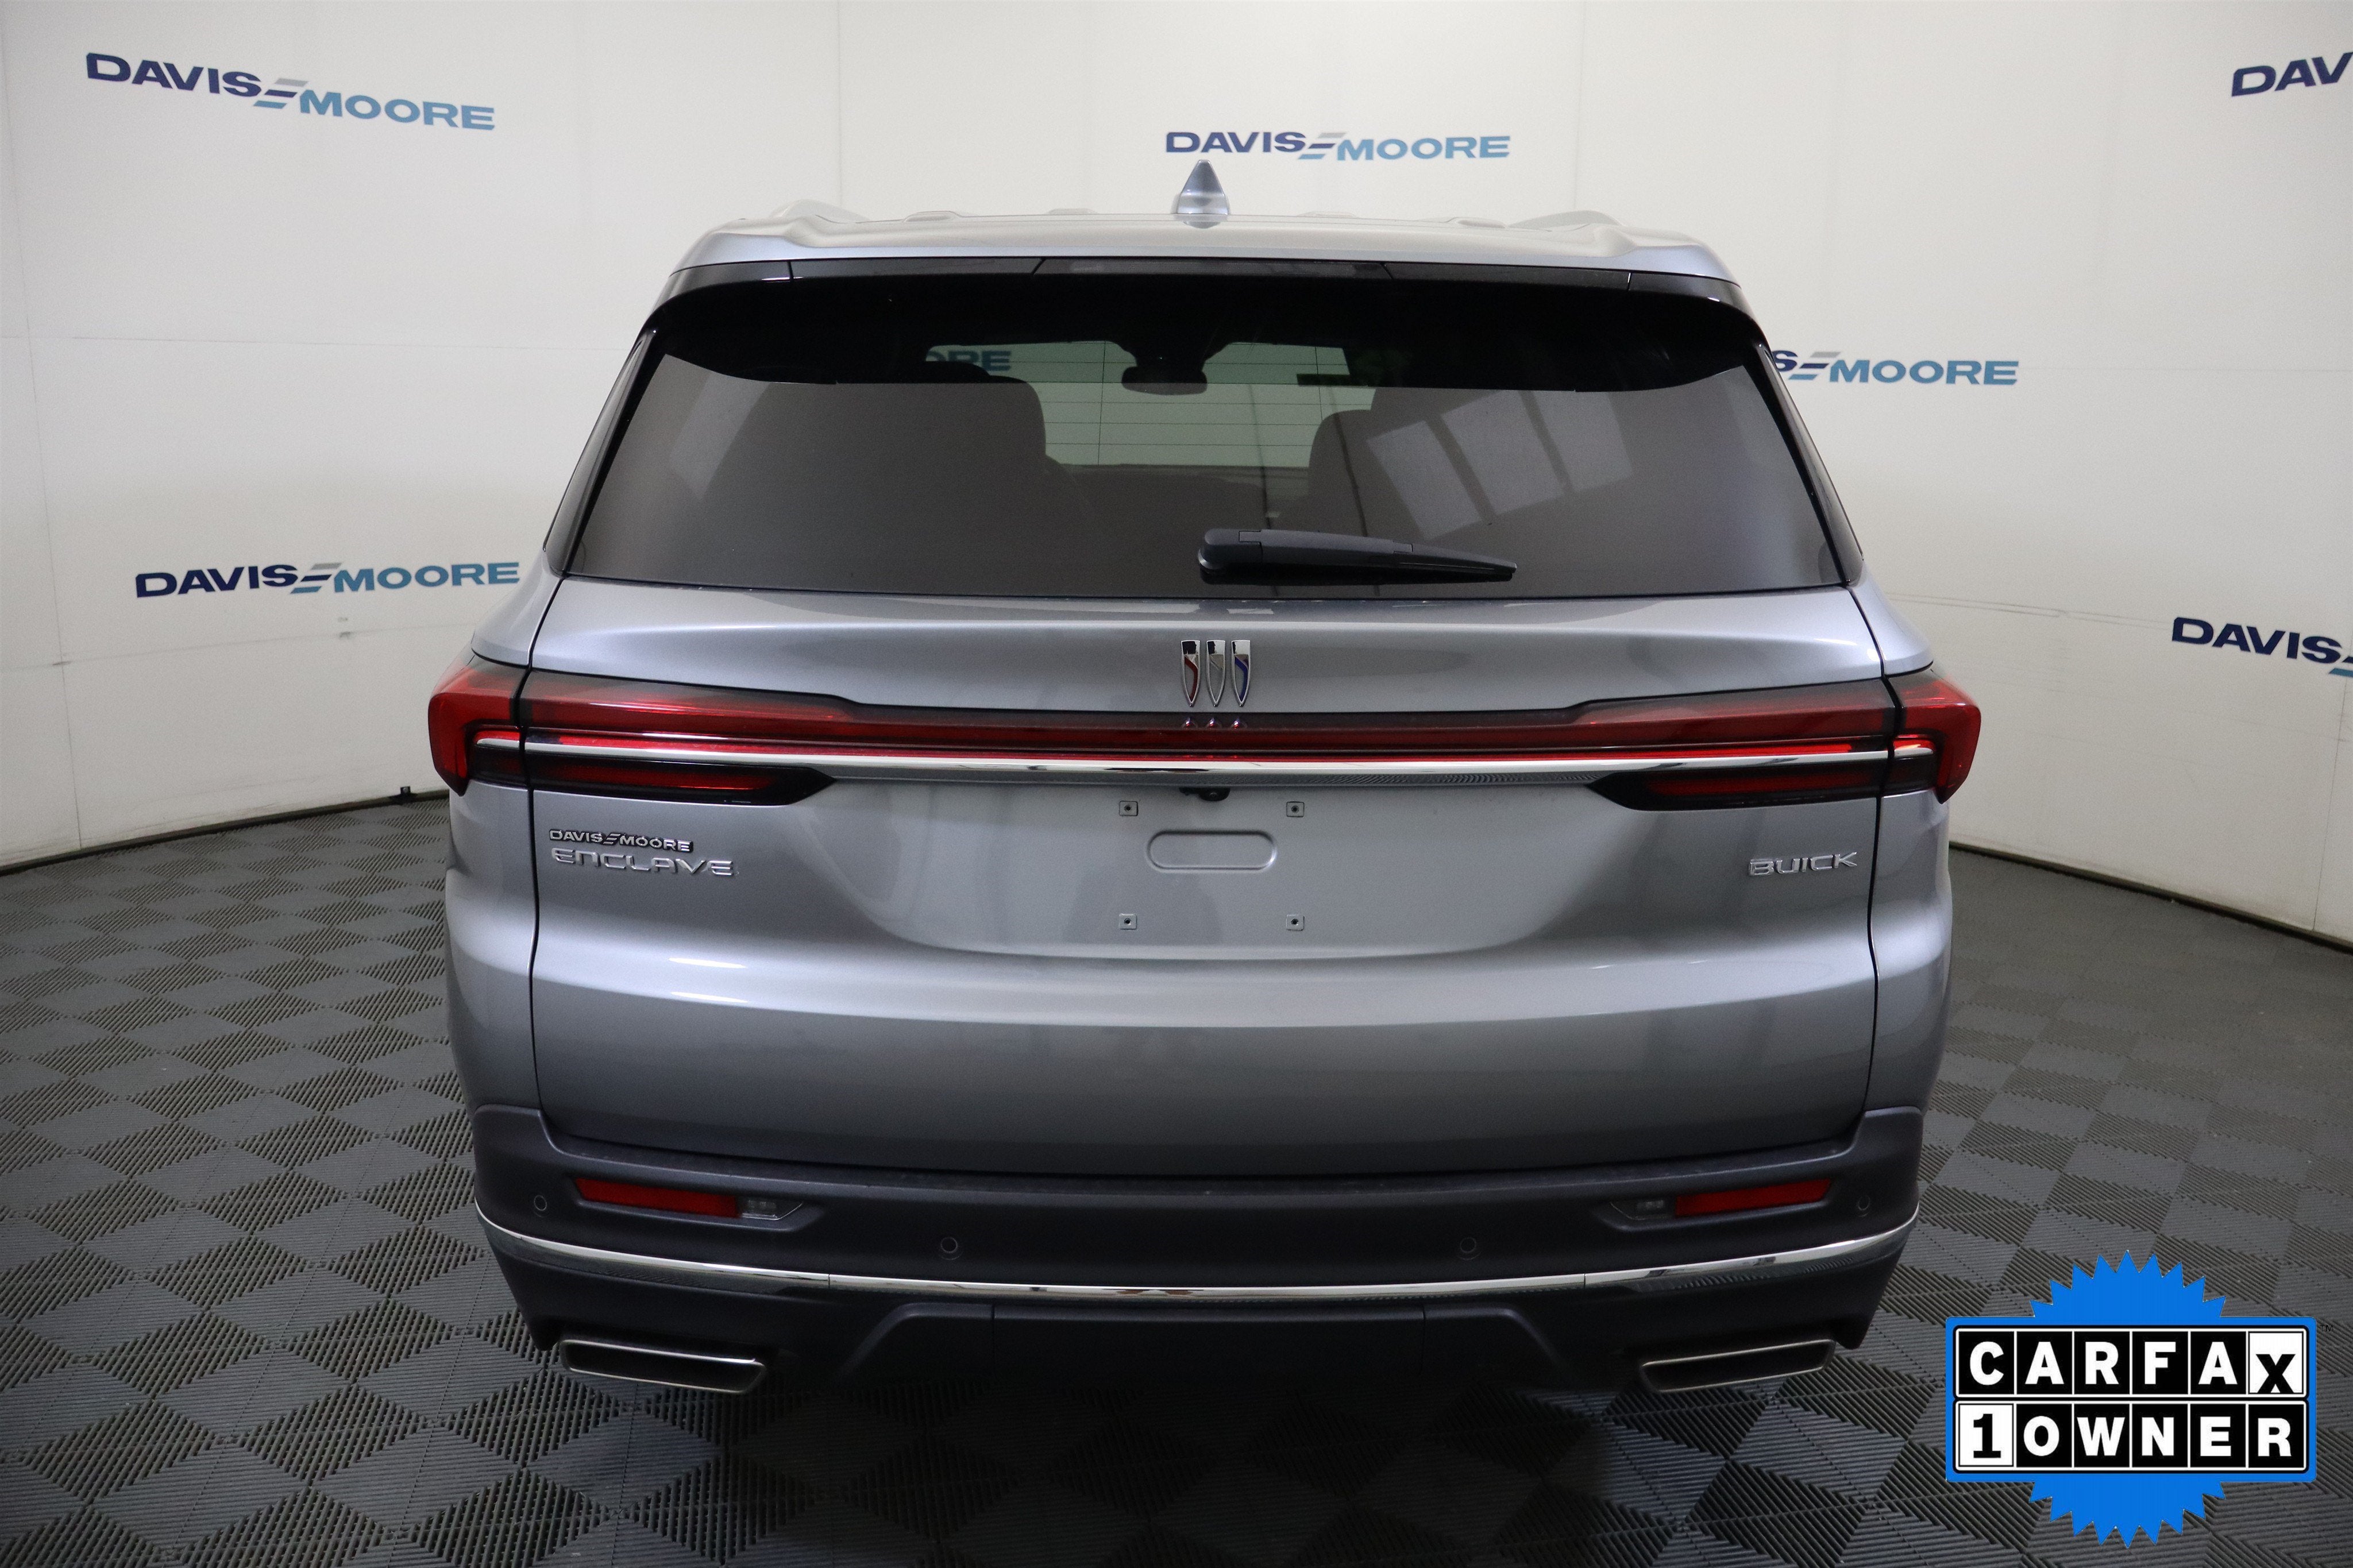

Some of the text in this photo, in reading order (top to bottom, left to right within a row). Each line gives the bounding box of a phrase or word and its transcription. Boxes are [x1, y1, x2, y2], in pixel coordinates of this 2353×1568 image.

[86, 52, 496, 131] DAVIS MOORE
[1166, 132, 1510, 160] DAVIS MOORE
[1830, 360, 2019, 385] MOORE
[135, 562, 520, 596] DAVIS MOORE
[2172, 617, 2343, 665] DAVIS
[550, 829, 692, 852] DAVIS MOORE
[551, 847, 734, 876] ENCLAVE
[1749, 852, 1857, 876] BUICK
